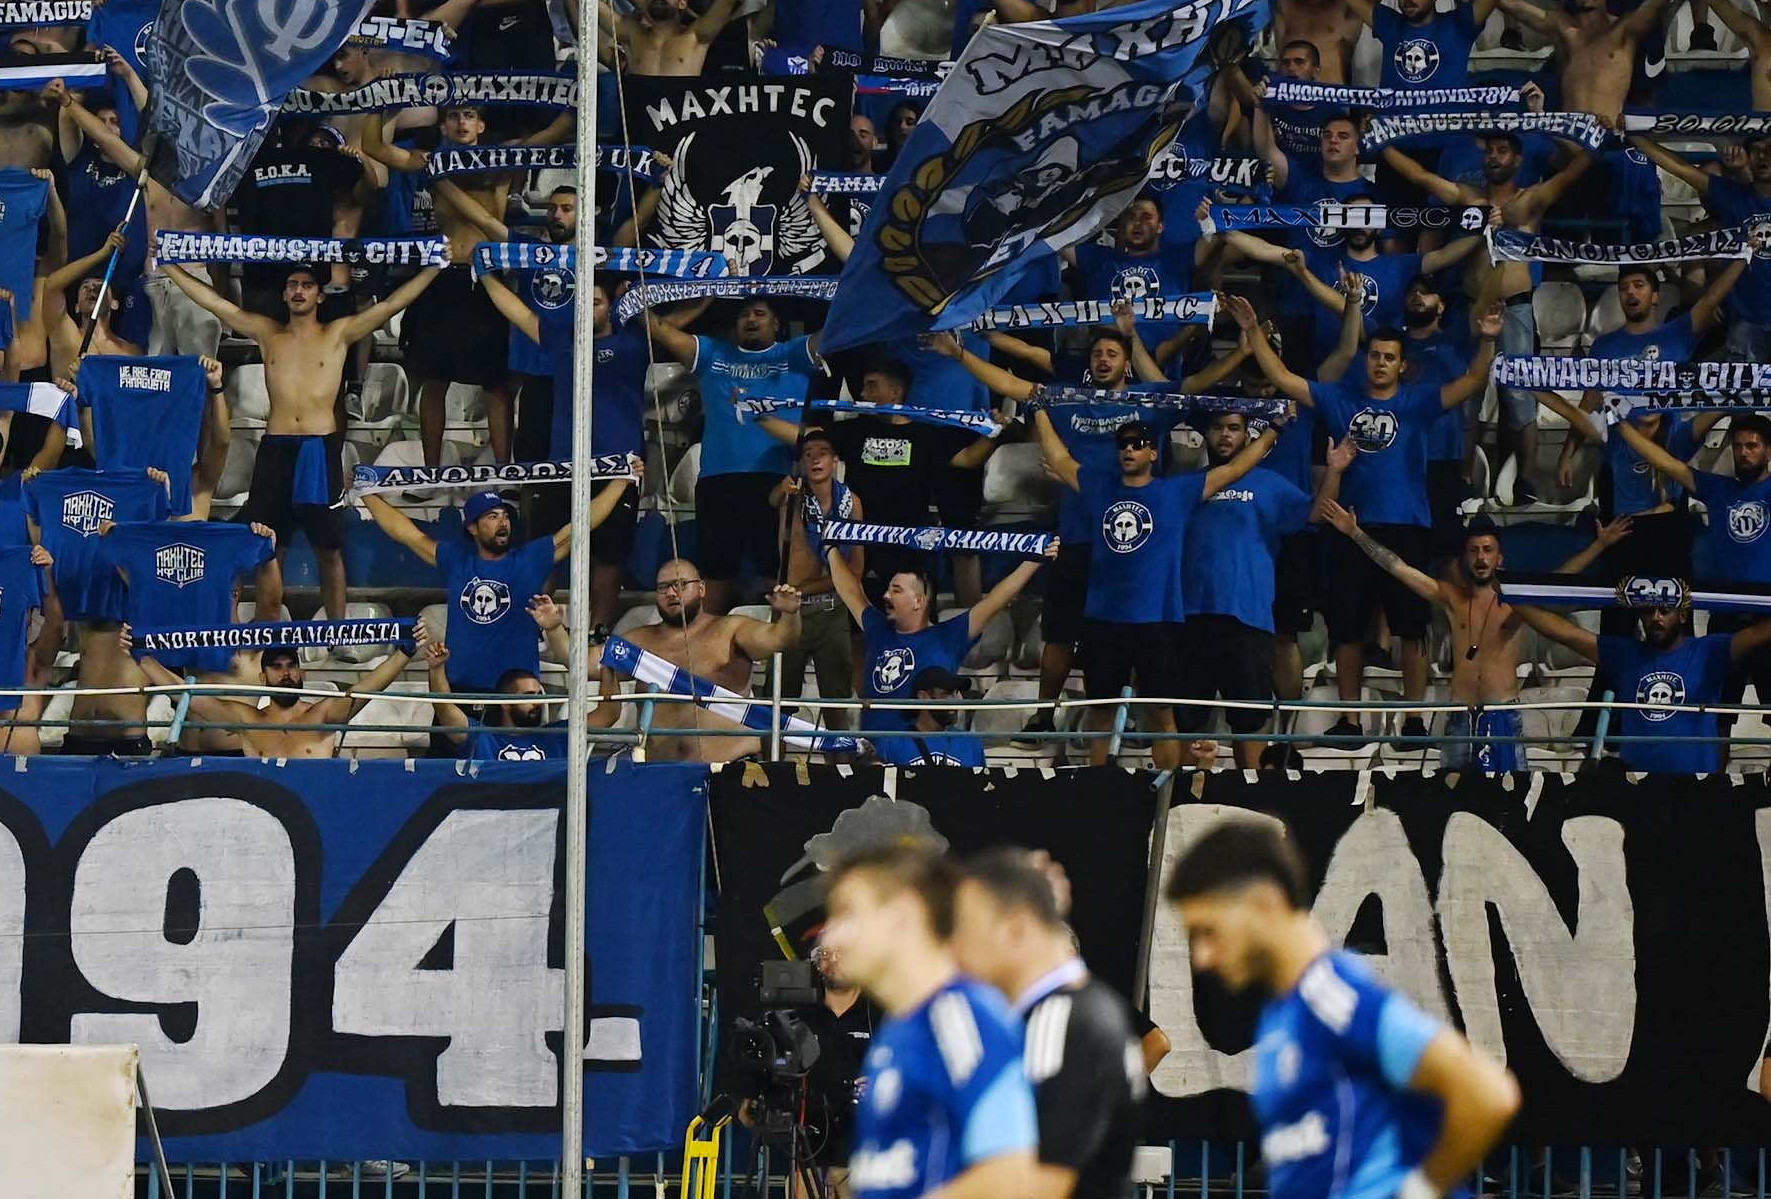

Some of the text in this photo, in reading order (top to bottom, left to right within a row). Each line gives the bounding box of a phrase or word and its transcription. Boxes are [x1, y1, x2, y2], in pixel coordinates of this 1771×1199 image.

[645, 84, 836, 133] MAXHTEC
[160, 232, 437, 266] FAMAGUSTA CITY
[1525, 225, 1743, 261] ΑΝΟΡΘΩΣΙΣ
[380, 456, 631, 487] ΑΝΟΡΘΩΣΣ
[944, 528, 1048, 556] SALONICA
[143, 621, 402, 651] ANORTHOSIS FAMAGUSTA
